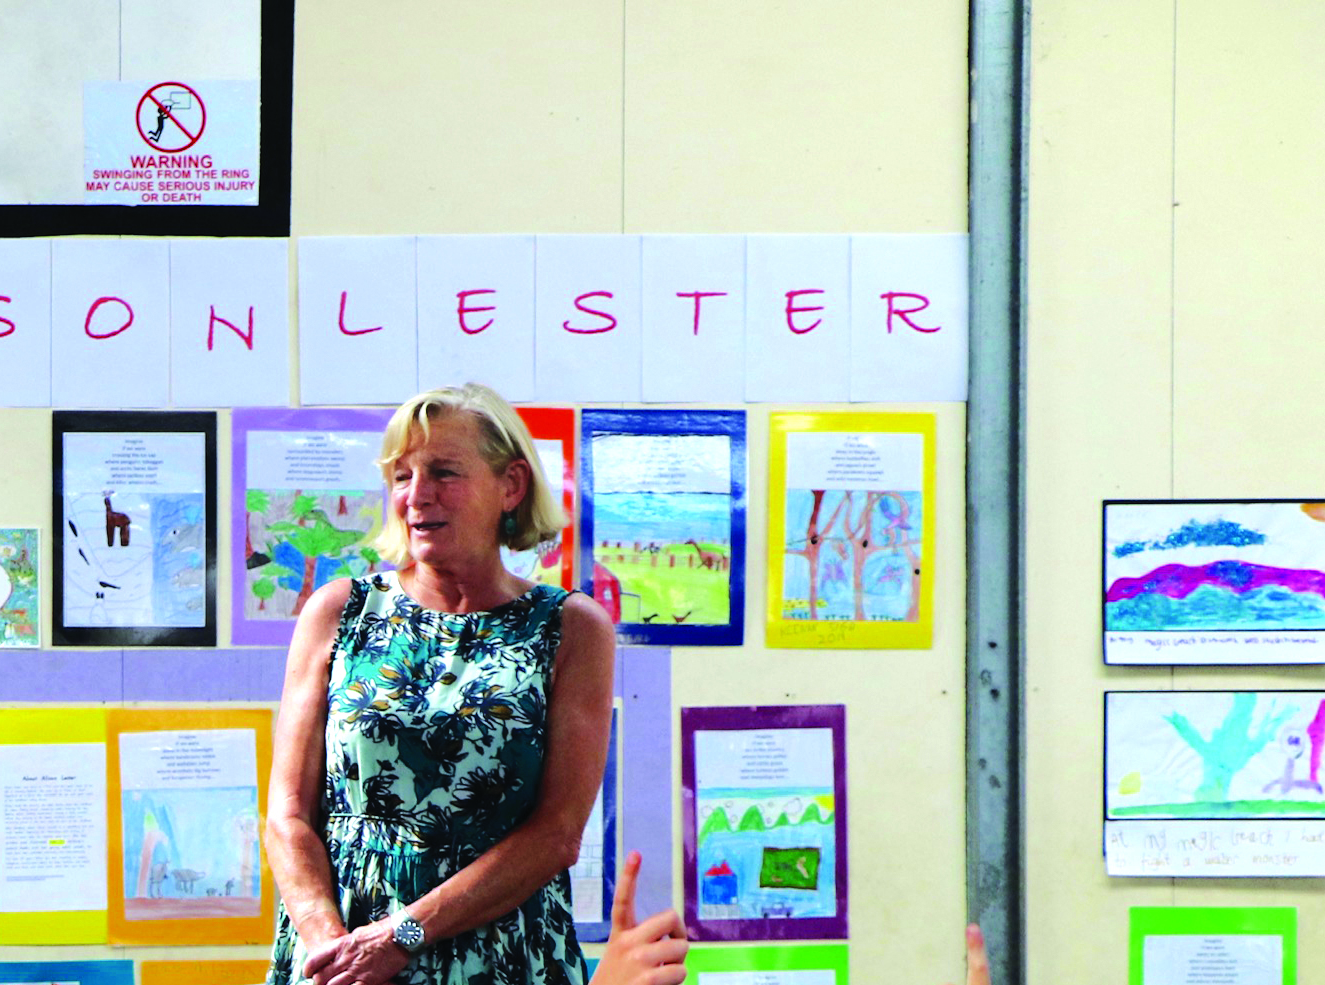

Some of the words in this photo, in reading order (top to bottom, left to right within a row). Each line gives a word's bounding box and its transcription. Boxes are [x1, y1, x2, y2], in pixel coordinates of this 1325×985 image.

[131, 155, 213, 169] WARNING
[93, 170, 153, 179] SWINGING
[157, 170, 191, 179] FROM
[196, 170, 217, 179] THE
[221, 170, 250, 179] RING
[86, 181, 109, 191] MAY
[114, 181, 154, 191] CAUSE
[158, 181, 210, 191] SERIOUS
[214, 181, 255, 191] INJURY
[141, 193, 158, 202] OR
[162, 193, 202, 202] DEATH
[339, 290, 940, 336] LESTER
